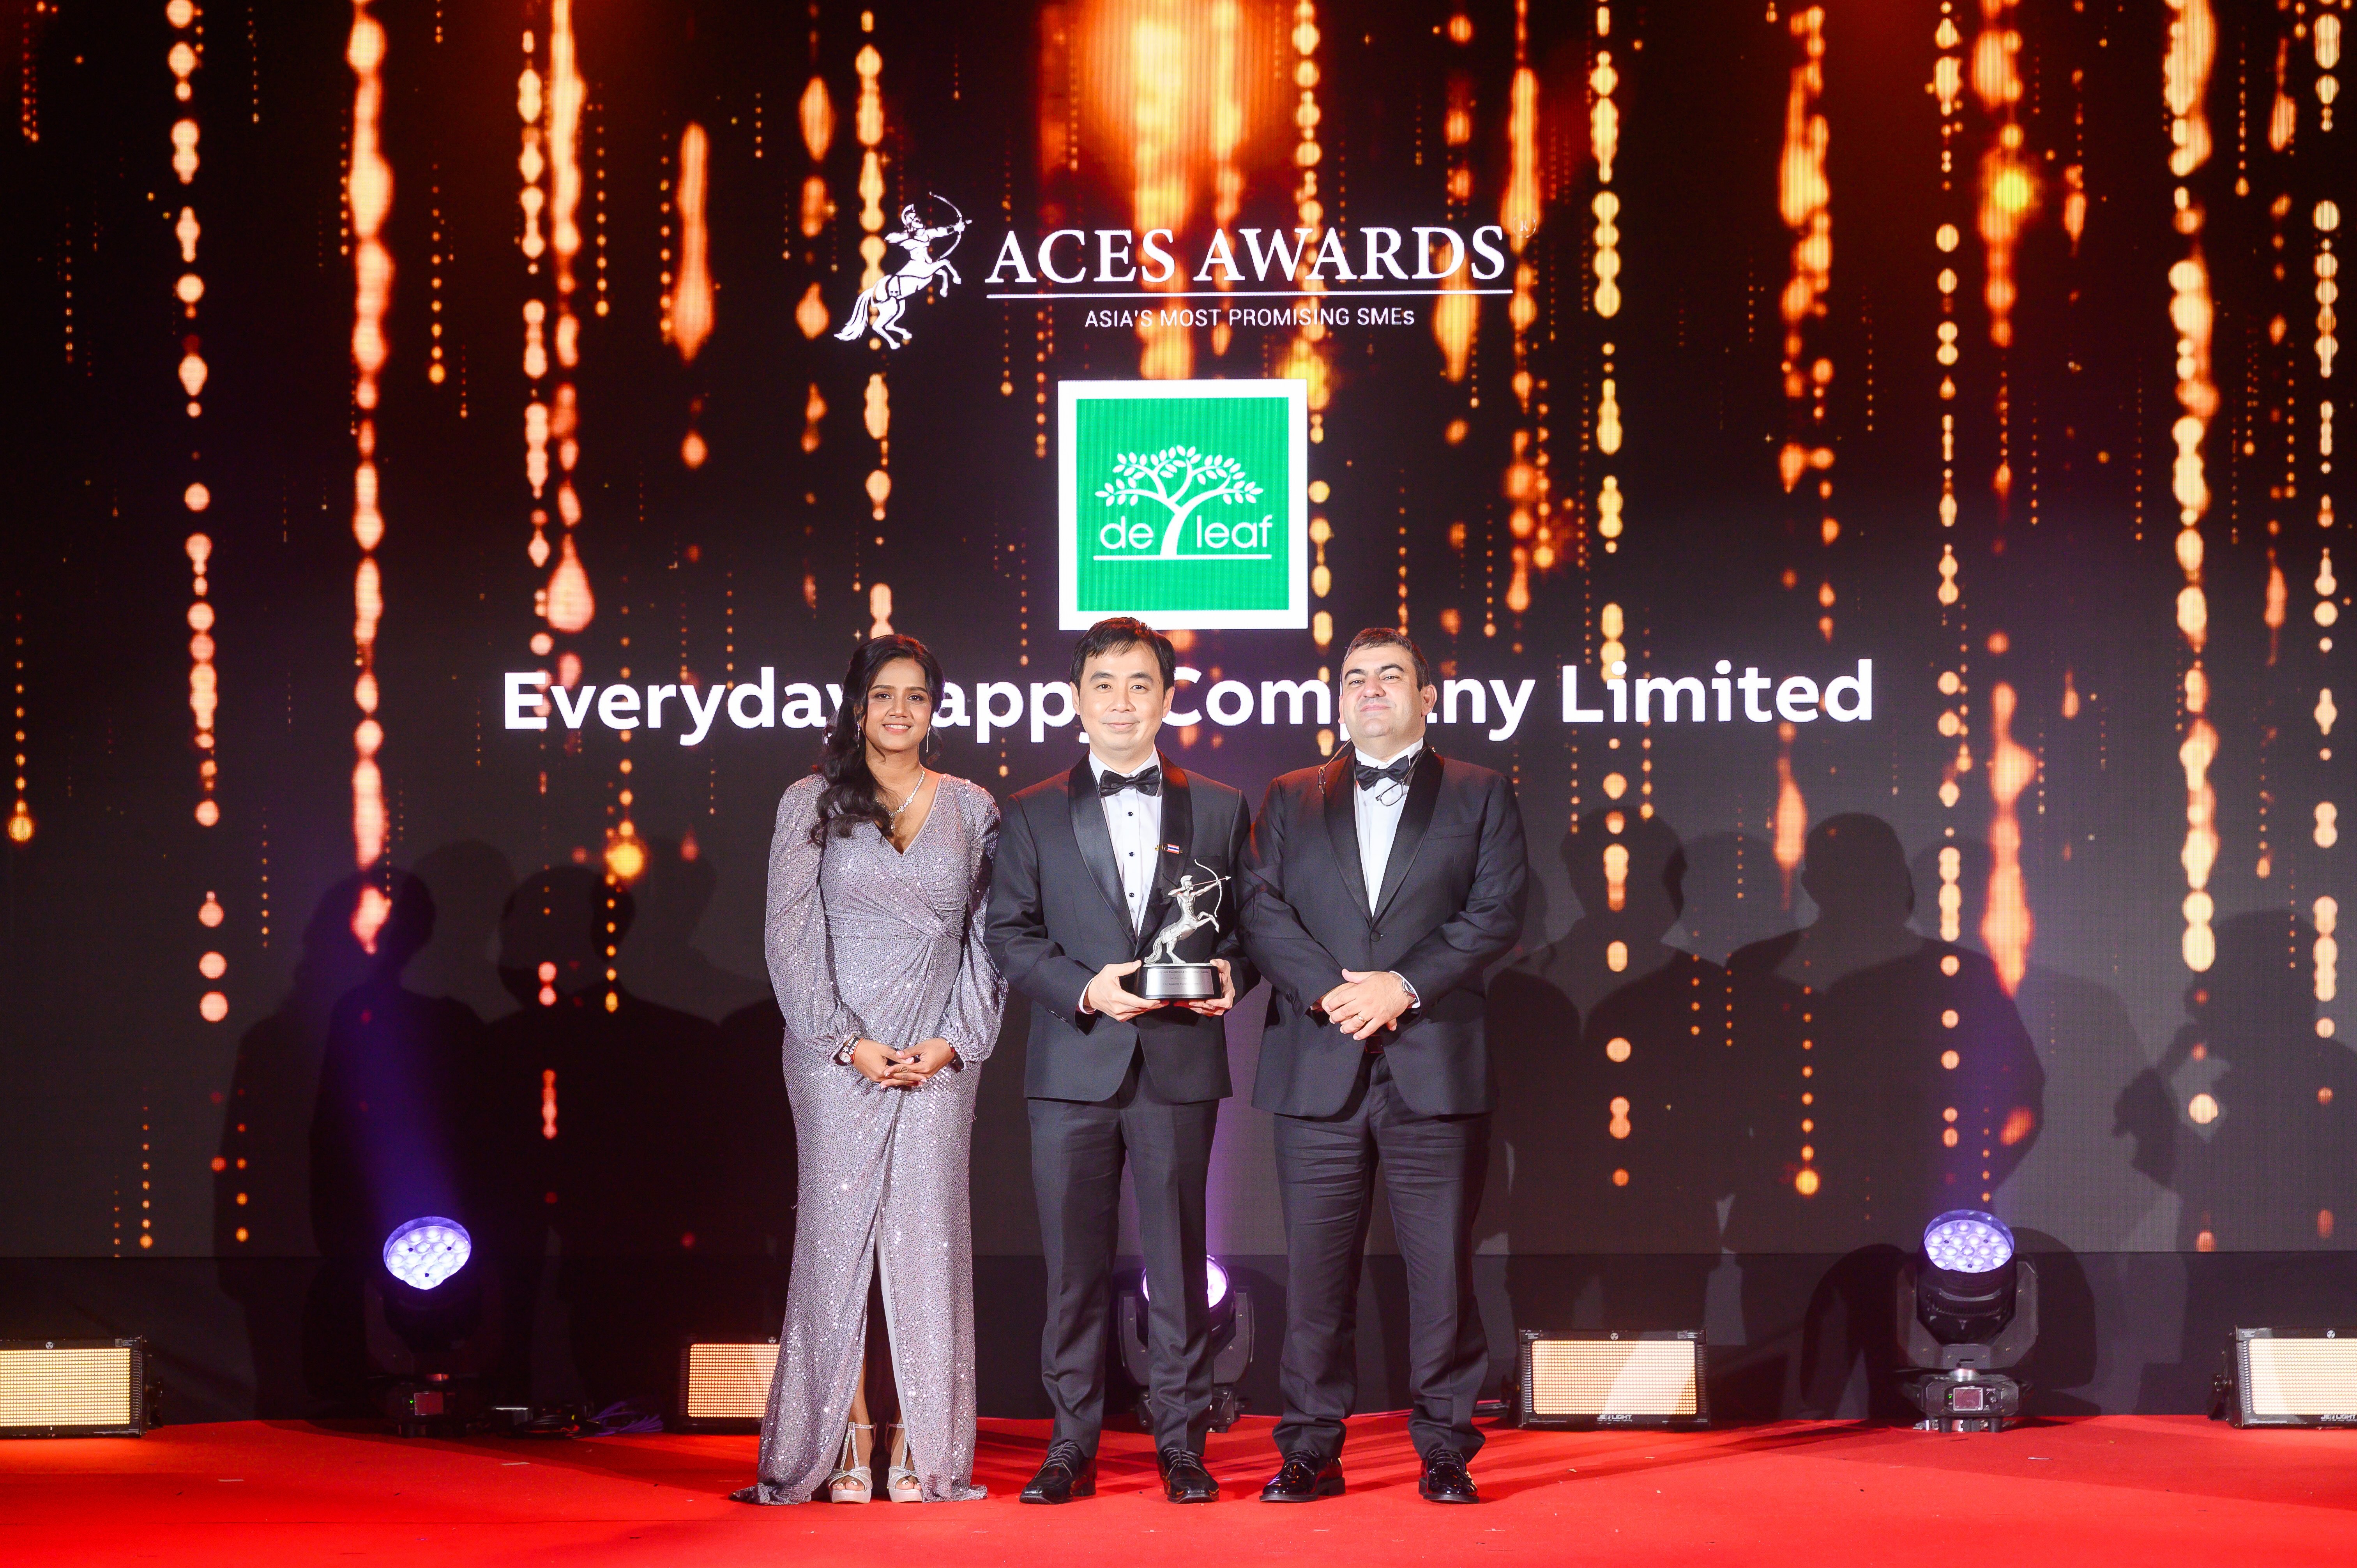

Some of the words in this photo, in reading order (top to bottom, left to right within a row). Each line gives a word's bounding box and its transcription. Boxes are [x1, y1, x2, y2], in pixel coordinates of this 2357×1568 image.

[985, 227, 1175, 283] ACES
[1193, 226, 1505, 282] AWARDS
[1085, 309, 1152, 328] ASIA'S
[1160, 309, 1221, 327] MOST
[1229, 308, 1349, 326] PROMISING
[1357, 307, 1415, 325] SMEs
[1100, 516, 1154, 549] de
[1197, 515, 1273, 548] leaf
[931, 681, 1090, 743] app
[1162, 666, 1536, 741] Comny
[1562, 659, 1872, 723] Limited
